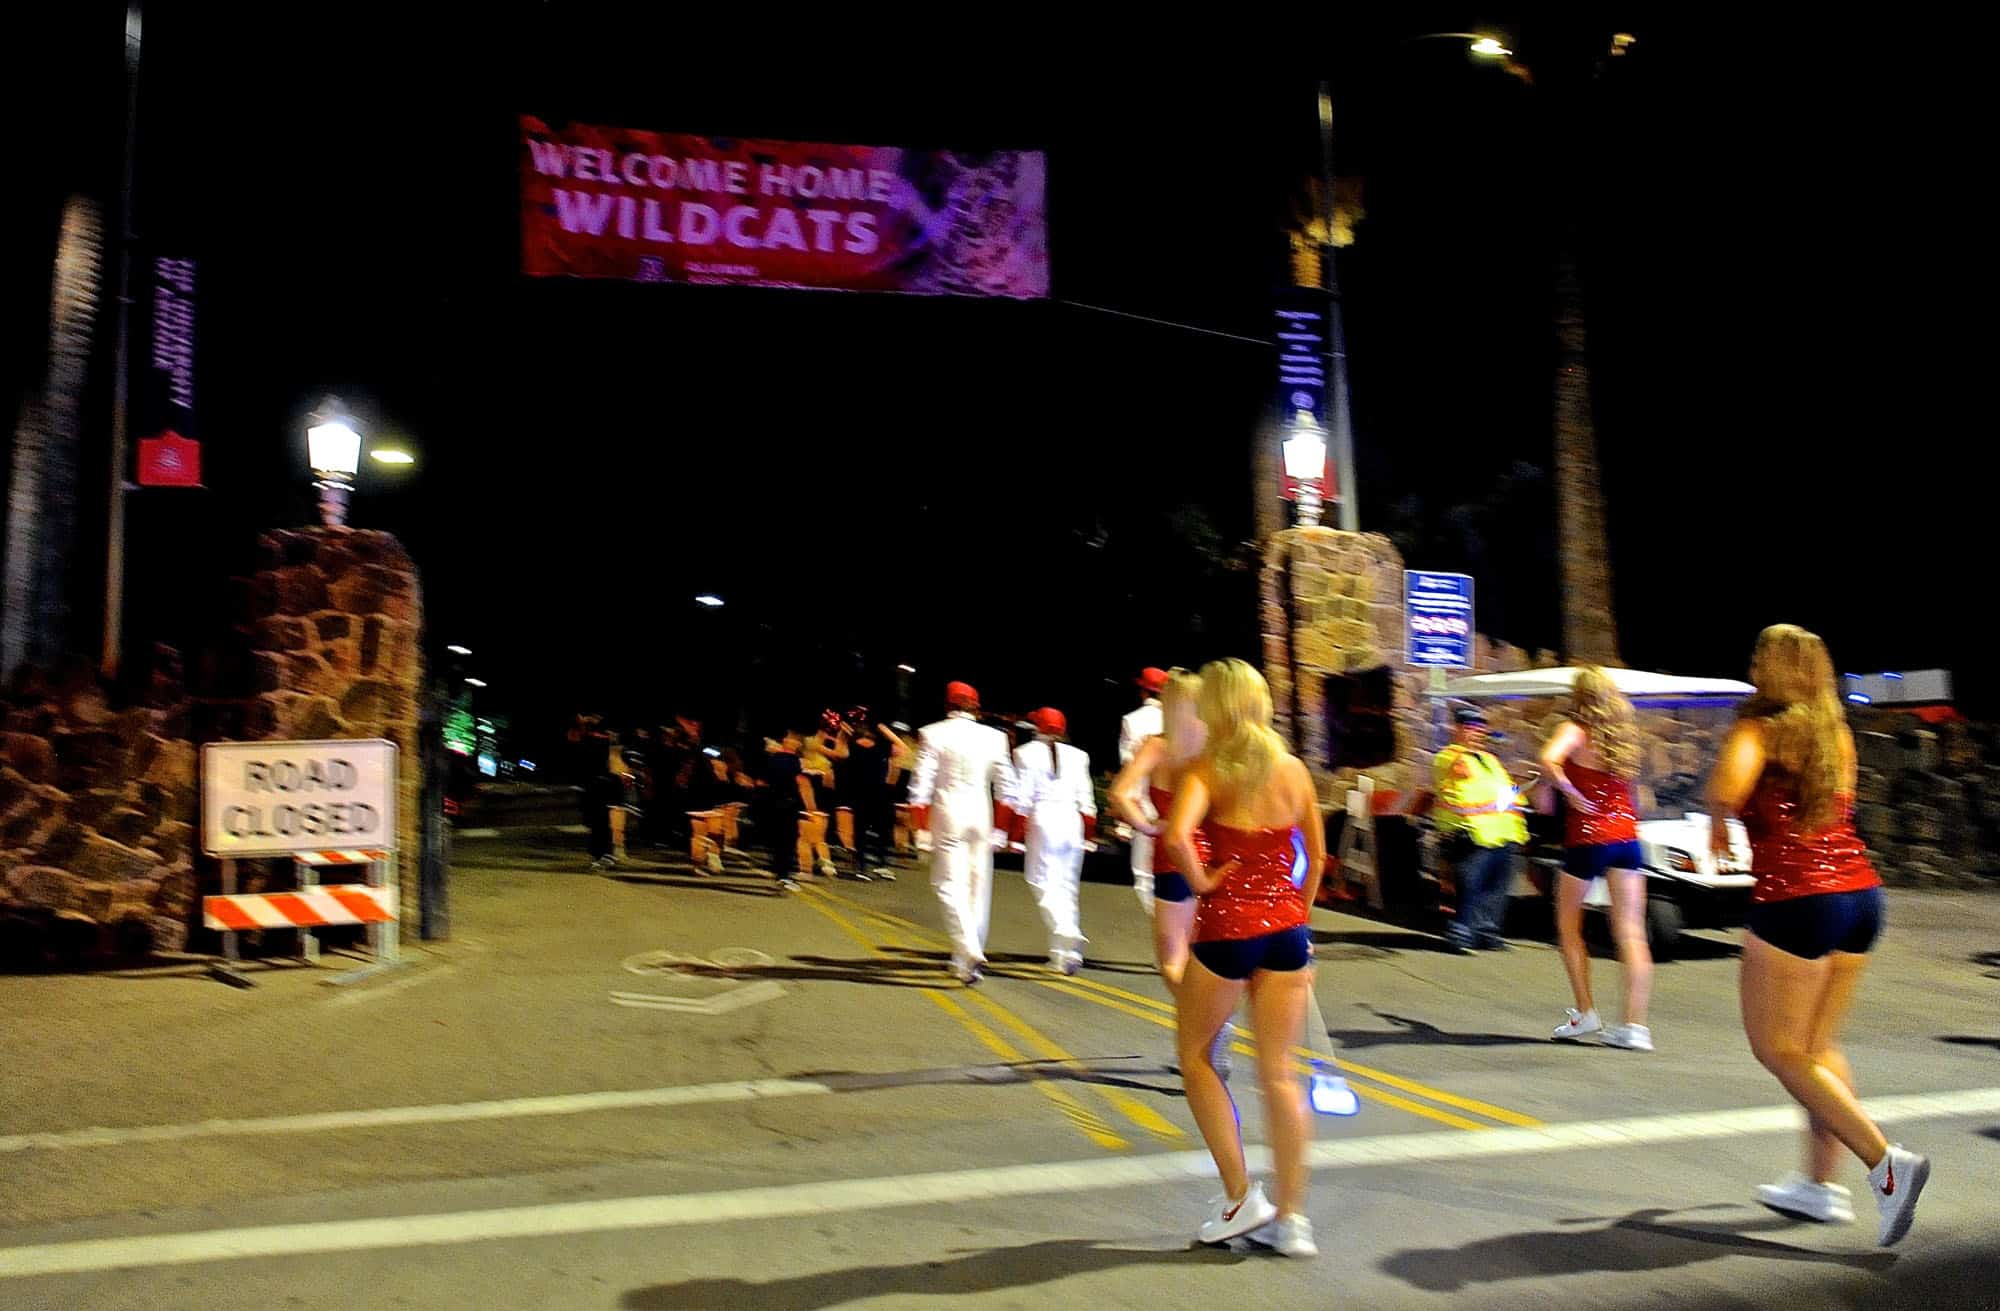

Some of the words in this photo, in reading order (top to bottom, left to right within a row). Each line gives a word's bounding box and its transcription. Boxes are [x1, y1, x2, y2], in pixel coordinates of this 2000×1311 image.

[528, 139, 747, 195] WELCOME
[760, 163, 893, 202] HOME
[554, 189, 879, 254] WILDCATS
[245, 759, 357, 793] ROAD
[222, 802, 380, 837] CLOSED
